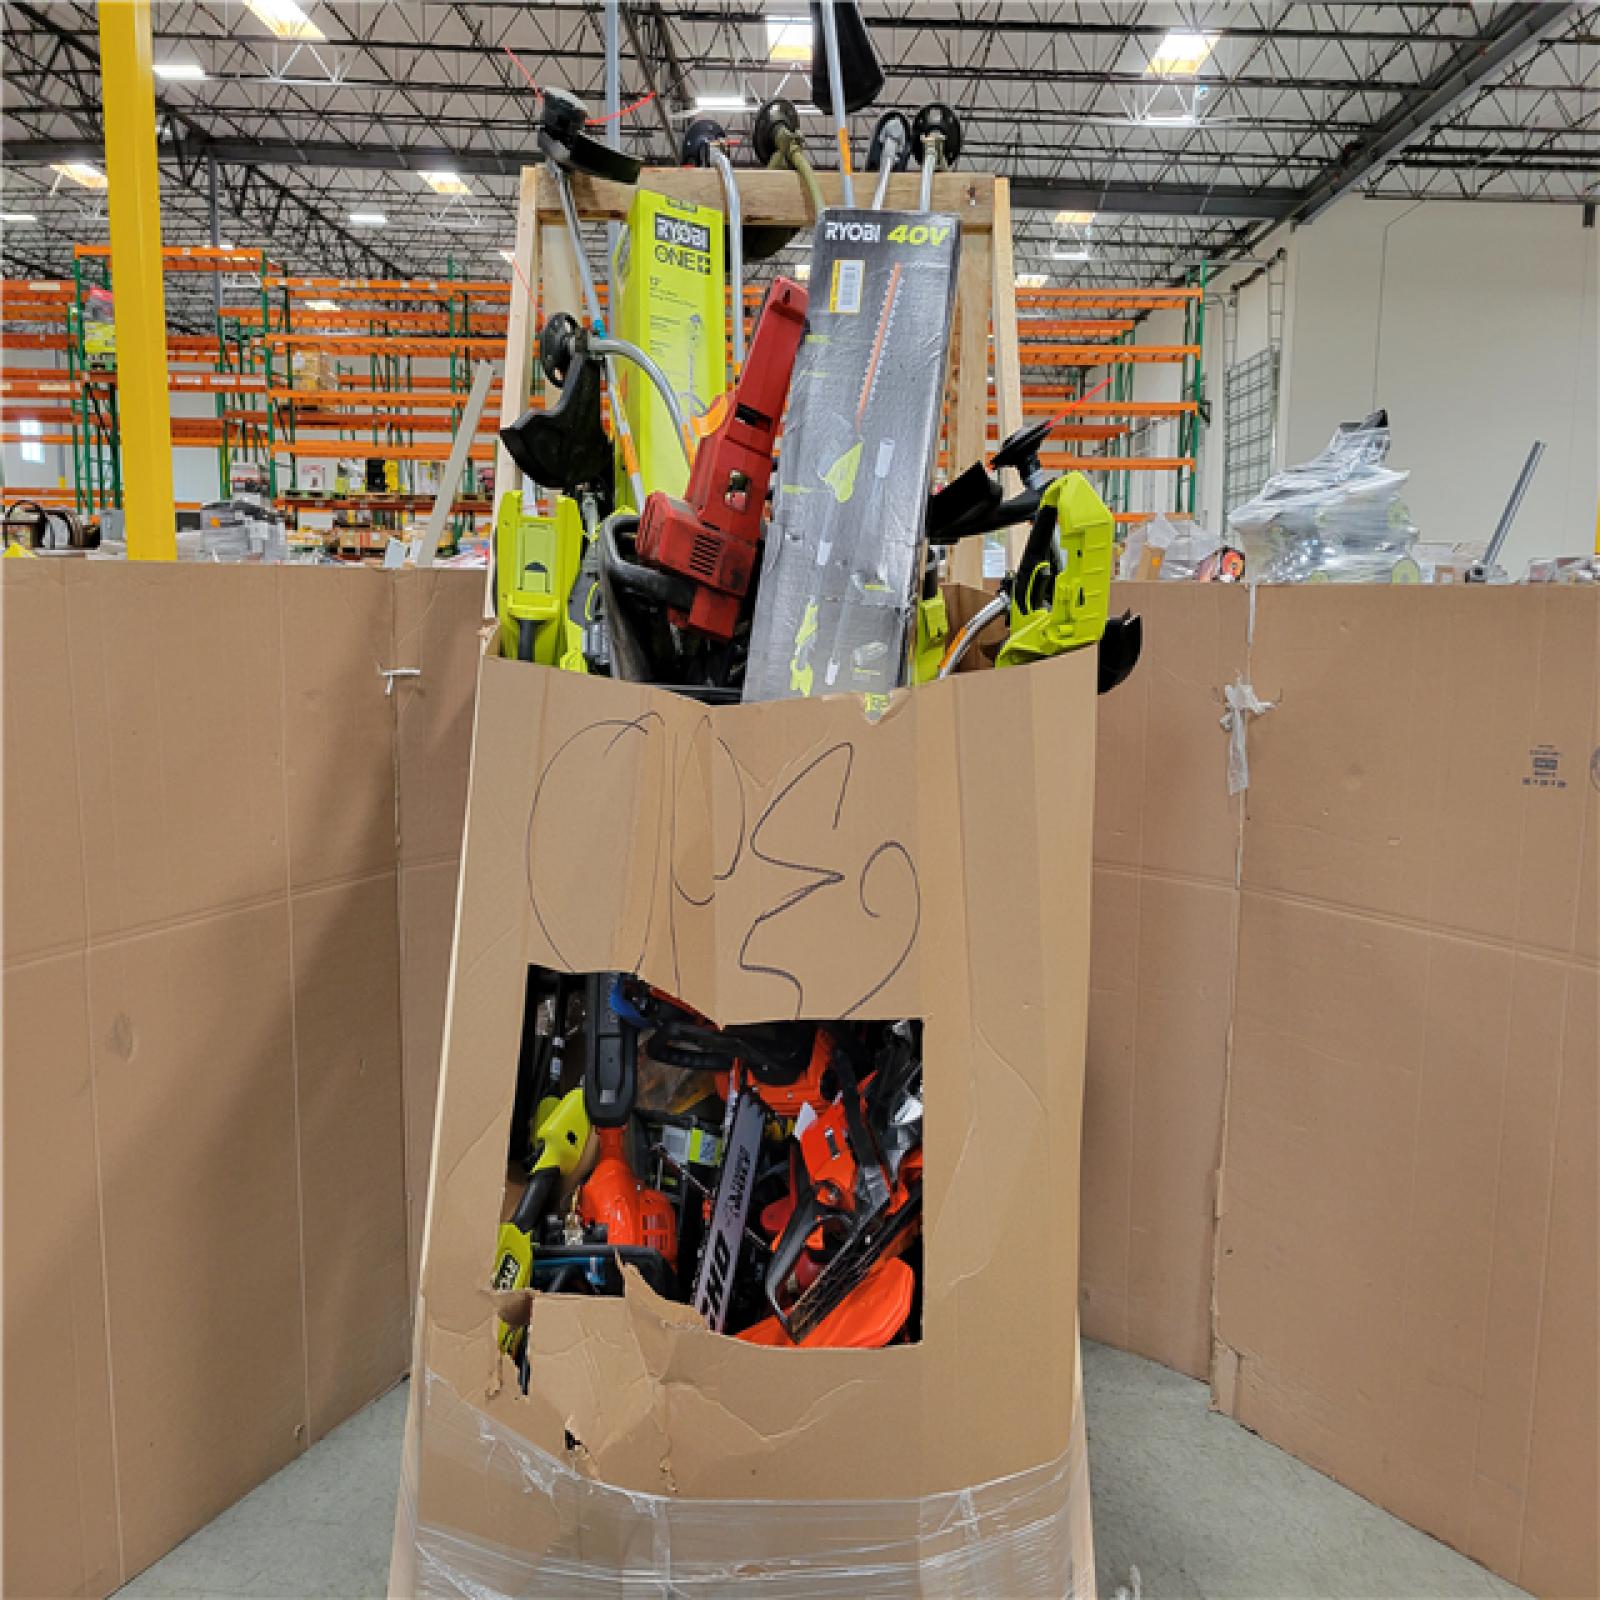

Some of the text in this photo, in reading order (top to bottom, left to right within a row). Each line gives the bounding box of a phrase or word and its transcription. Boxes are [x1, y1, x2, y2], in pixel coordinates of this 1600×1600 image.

[656, 215, 707, 249] RYOBI
[824, 221, 950, 247] RYOBI 40V
